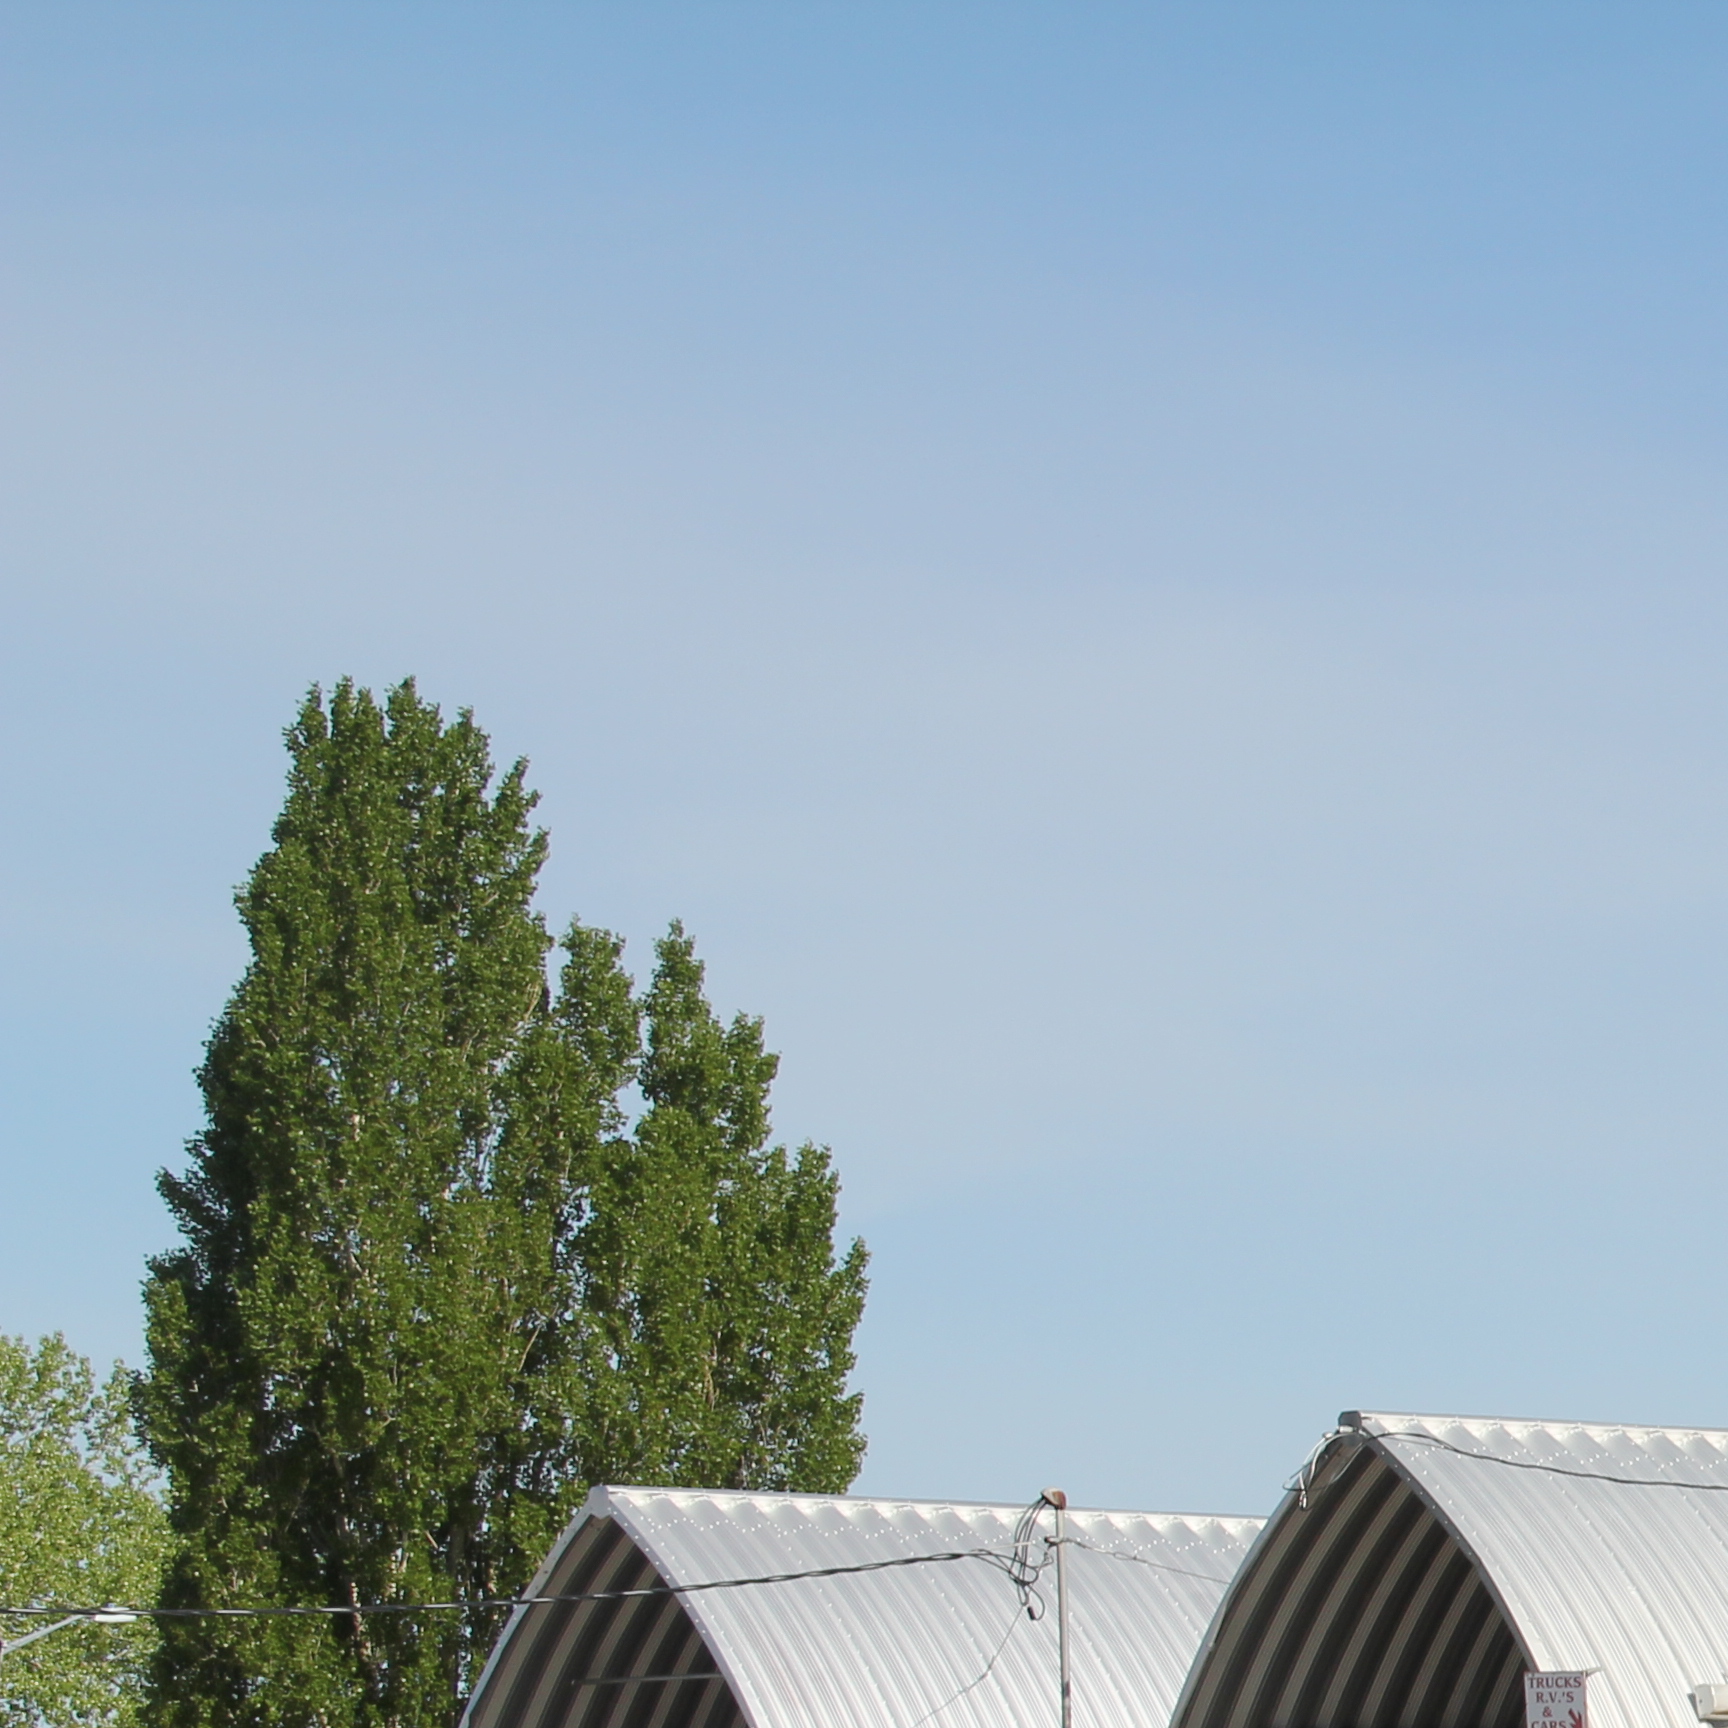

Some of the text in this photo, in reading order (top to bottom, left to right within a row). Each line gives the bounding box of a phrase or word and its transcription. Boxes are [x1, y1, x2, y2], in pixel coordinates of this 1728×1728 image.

[1528, 1676, 1582, 1689] TRUCKS
[1536, 1691, 1574, 1703] R.V.'S
[1542, 1706, 1553, 1718] &
